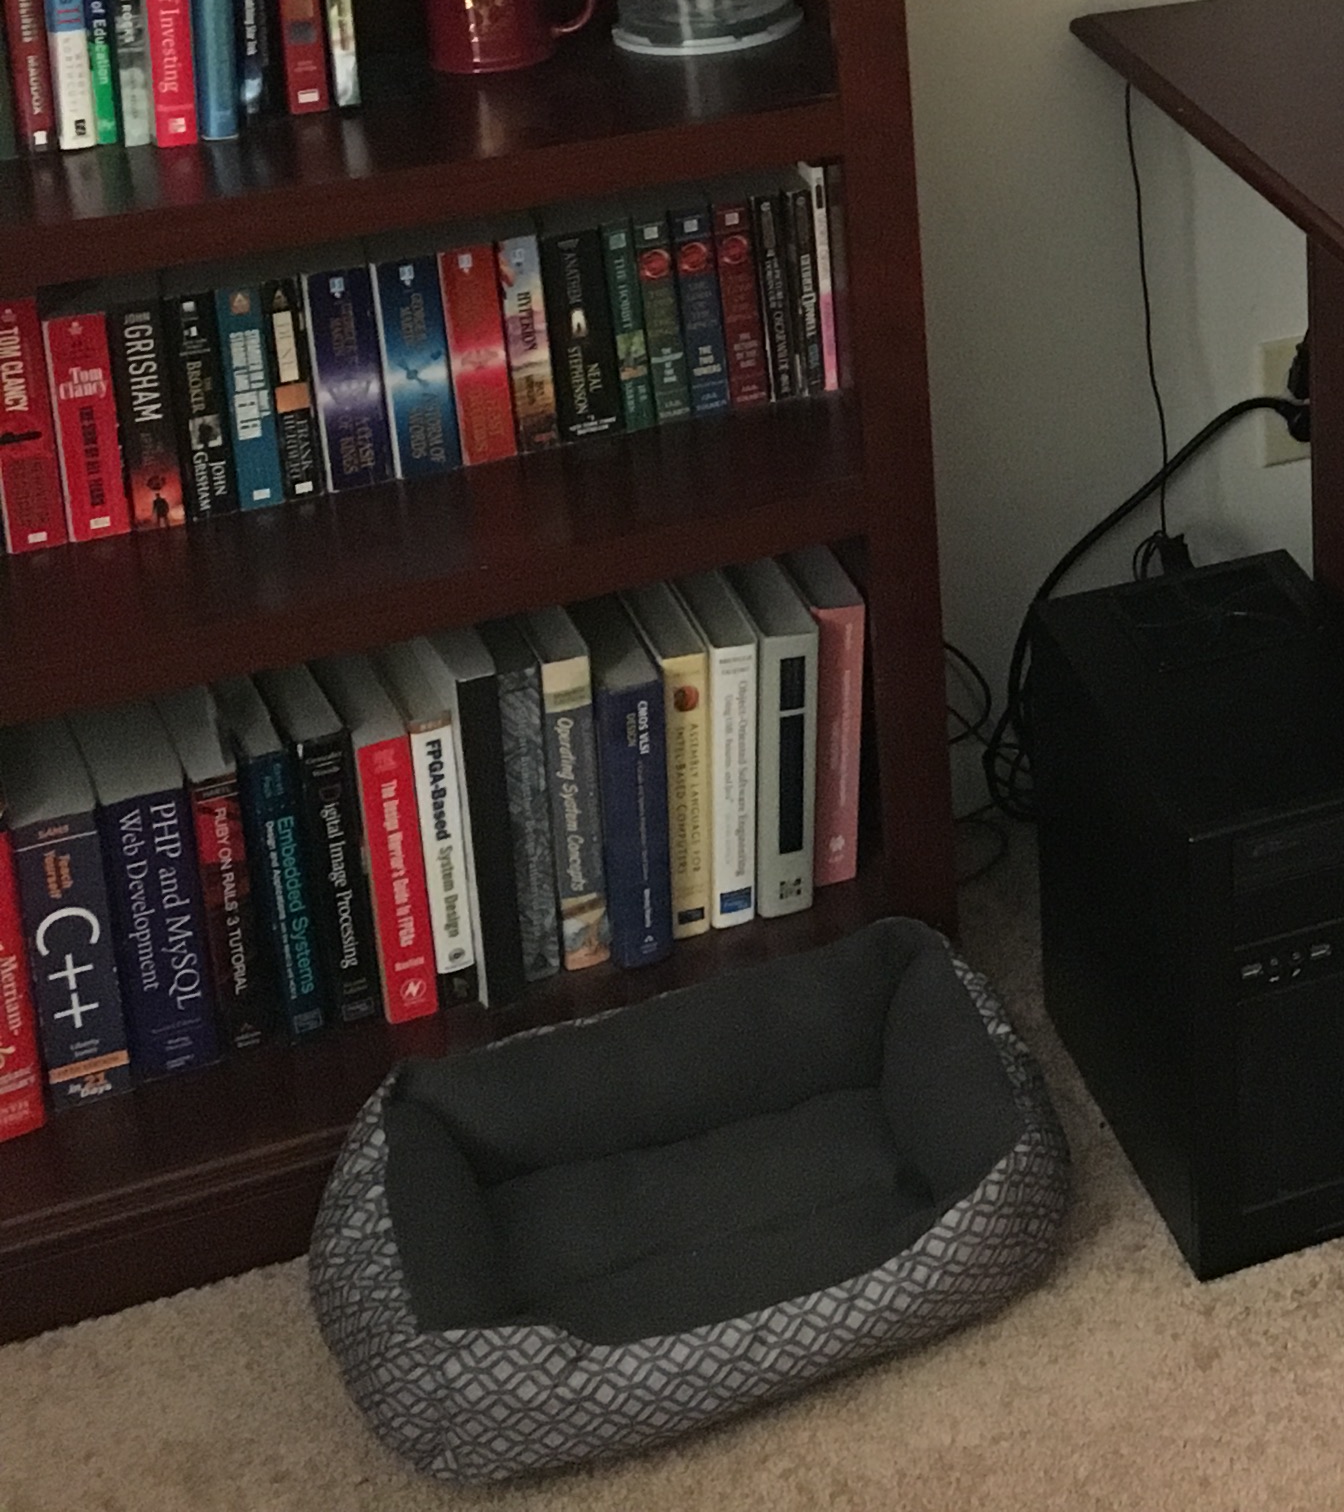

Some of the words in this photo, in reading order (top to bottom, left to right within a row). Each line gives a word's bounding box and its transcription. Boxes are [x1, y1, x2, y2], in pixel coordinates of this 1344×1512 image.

[92, 1, 104, 14] of
[92, 19, 111, 85] Education
[158, 5, 180, 94] Investing
[26, 54, 44, 116] MADDOX
[58, 380, 108, 400] Clancy
[68, 367, 103, 385] Tom
[125, 324, 164, 423] GRISHAM
[186, 359, 206, 414] BROKER
[568, 345, 589, 415] STEPHENSON
[586, 362, 602, 394] NEAL
[191, 450, 212, 512] GRISHAM
[208, 460, 228, 496] JOHN
[429, 446, 446, 463] OF
[637, 699, 650, 731] CMOS
[735, 679, 749, 765] Object-Oriented
[555, 716, 581, 781] Operating
[638, 732, 650, 755] VLSI
[674, 725, 688, 799] INTEL-BASED
[688, 721, 701, 778] ASSEMBLY
[318, 782, 346, 838] Digital
[382, 777, 400, 799] The
[425, 738, 452, 842] FPGA-Based
[561, 783, 582, 833] System
[689, 782, 702, 845] LANGUAGE
[738, 766, 749, 811] Software
[118, 808, 145, 857] Web
[148, 799, 183, 859] PHP
[213, 806, 236, 845] RUBY
[265, 819, 278, 851] Design
[675, 803, 690, 875] COMPUTERS
[734, 814, 748, 877] Engineering
[219, 847, 236, 871] ON
[276, 814, 306, 913] Embedded
[327, 841, 350, 888] Image
[438, 843, 457, 893] System
[566, 834, 588, 892] Concepts
[691, 848, 703, 873] FOR
[157, 865, 186, 910] and
[126, 858, 160, 994] Development
[226, 915, 240, 927] 3
[334, 889, 360, 970] Processing
[442, 894, 462, 939] Design
[36, 907, 100, 1029] C++
[161, 913, 203, 1011] MySQL
[227, 928, 249, 996] TUTORIAL
[289, 917, 318, 995] Systems
